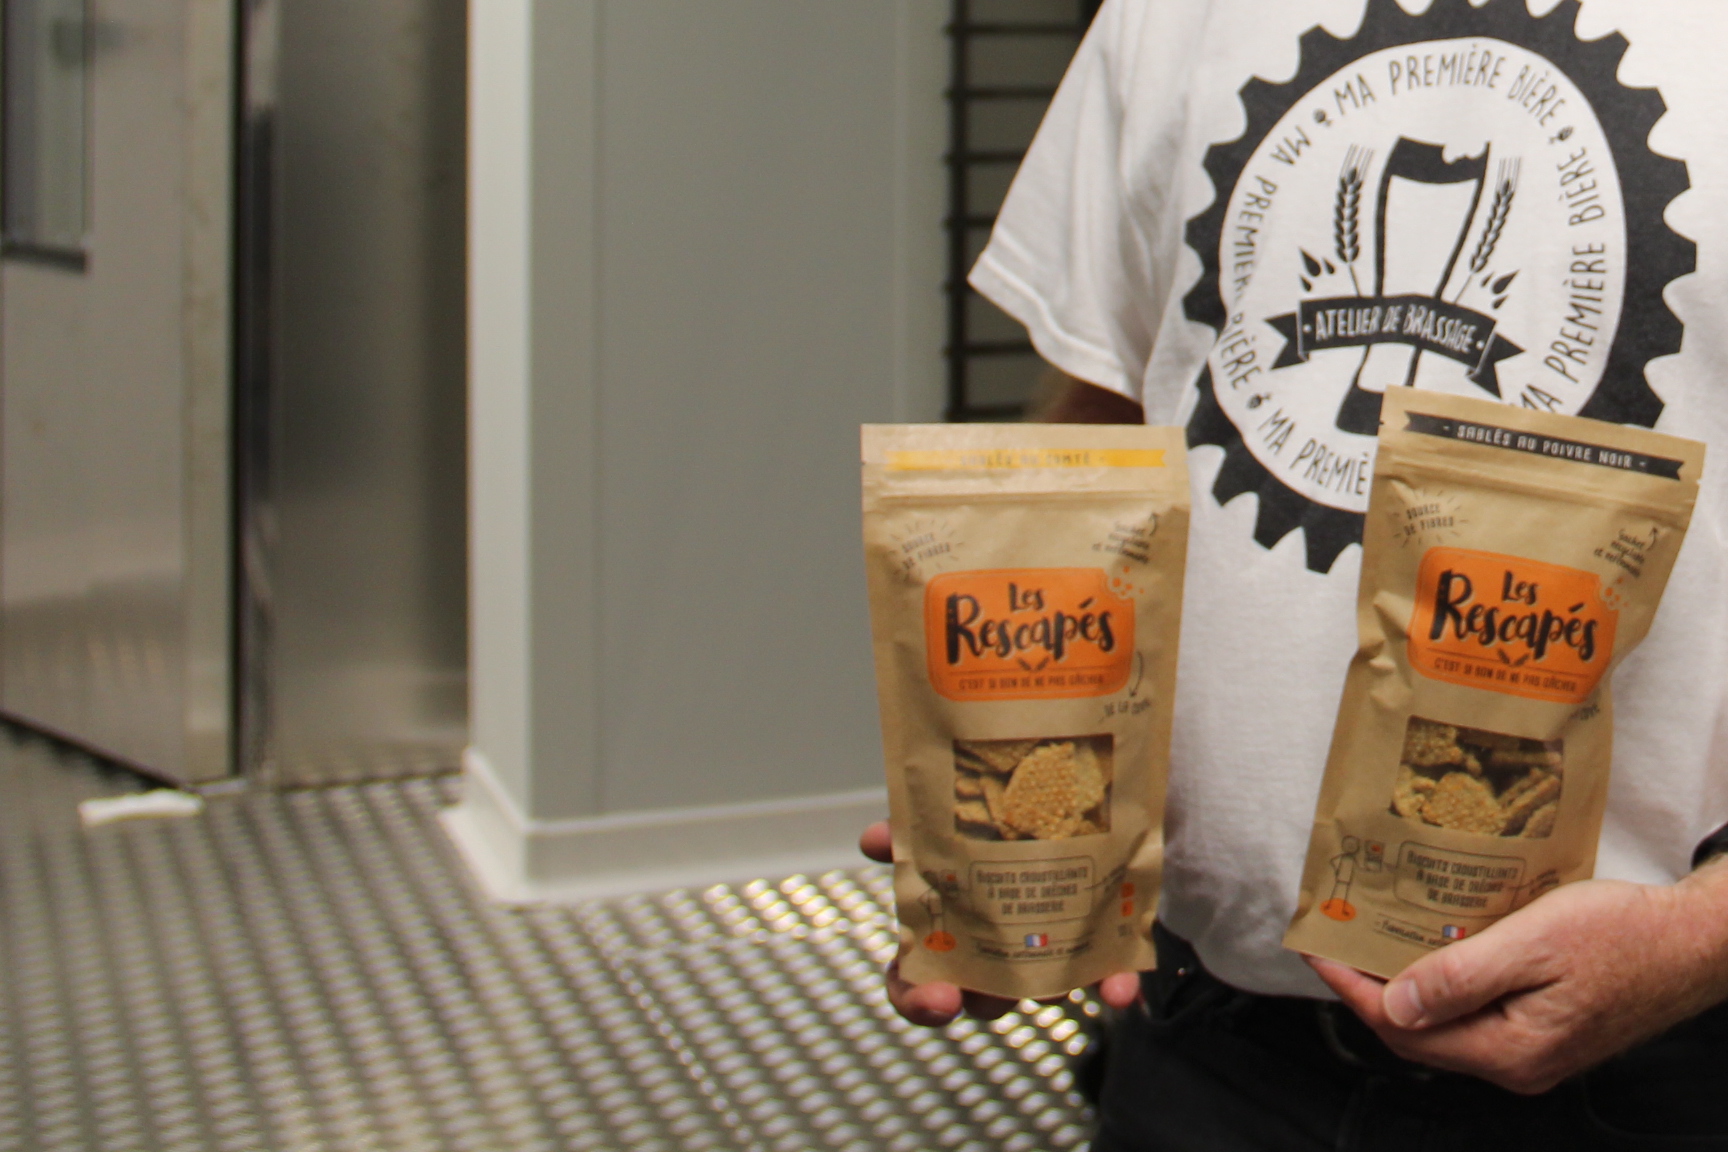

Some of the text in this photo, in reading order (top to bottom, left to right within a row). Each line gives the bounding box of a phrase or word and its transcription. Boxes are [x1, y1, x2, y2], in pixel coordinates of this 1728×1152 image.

[1334, 42, 1566, 127] MA PREMIÈRE BIÈRE
[1269, 124, 1311, 166] MA
[1556, 146, 1606, 227] BIÈRE
[1315, 303, 1477, 353] ATELIER DE BRASSAGE
[1543, 242, 1607, 384] PREMIÈRE
[1257, 407, 1369, 496] MA PREMIÈ
[1516, 435, 1537, 451] AU
[1542, 439, 1592, 462] POIVRE
[1598, 450, 1633, 469] NOIR
[1008, 581, 1045, 613] Les
[1429, 568, 1598, 662] Rescapés
[1501, 570, 1539, 605] Les
[945, 593, 1116, 666] Rescapés
